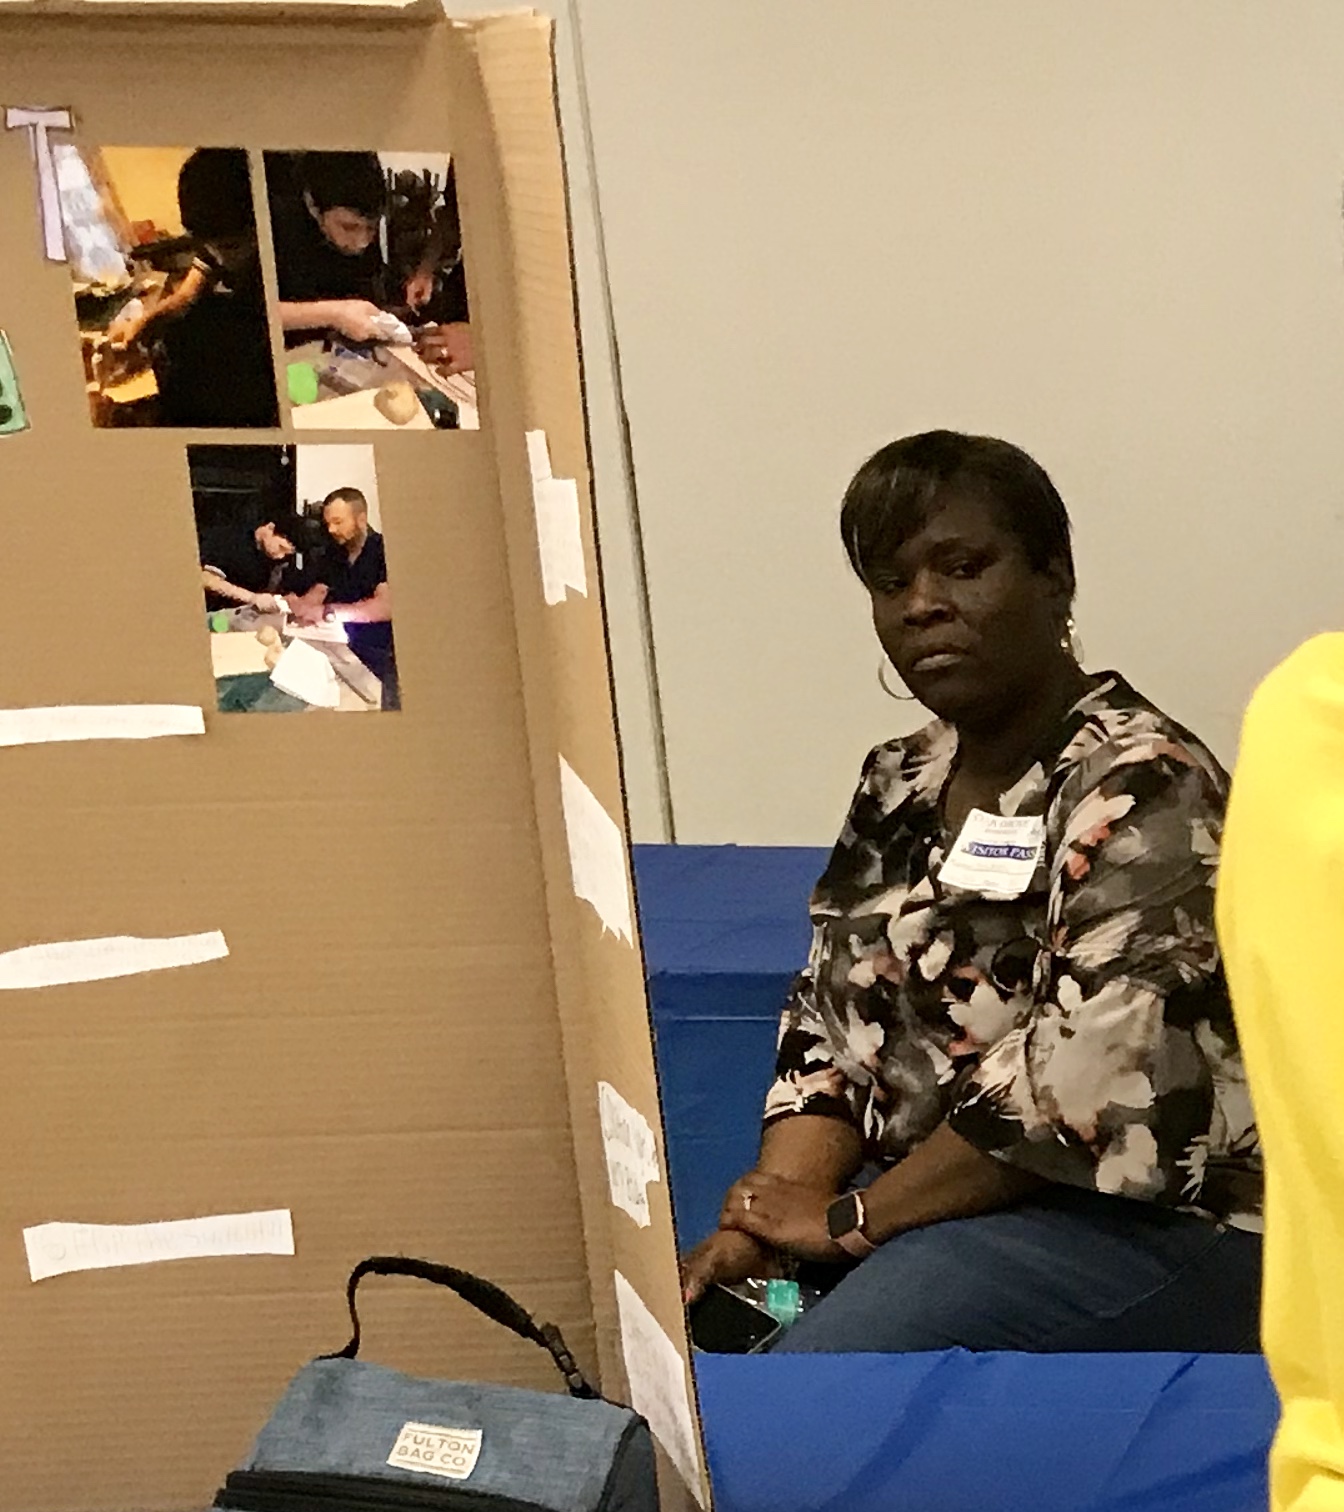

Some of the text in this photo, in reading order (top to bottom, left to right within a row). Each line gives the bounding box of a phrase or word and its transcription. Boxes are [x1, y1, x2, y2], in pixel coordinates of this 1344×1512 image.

[404, 1433, 475, 1455] FULTON
[397, 1446, 465, 1466] BAG CO
